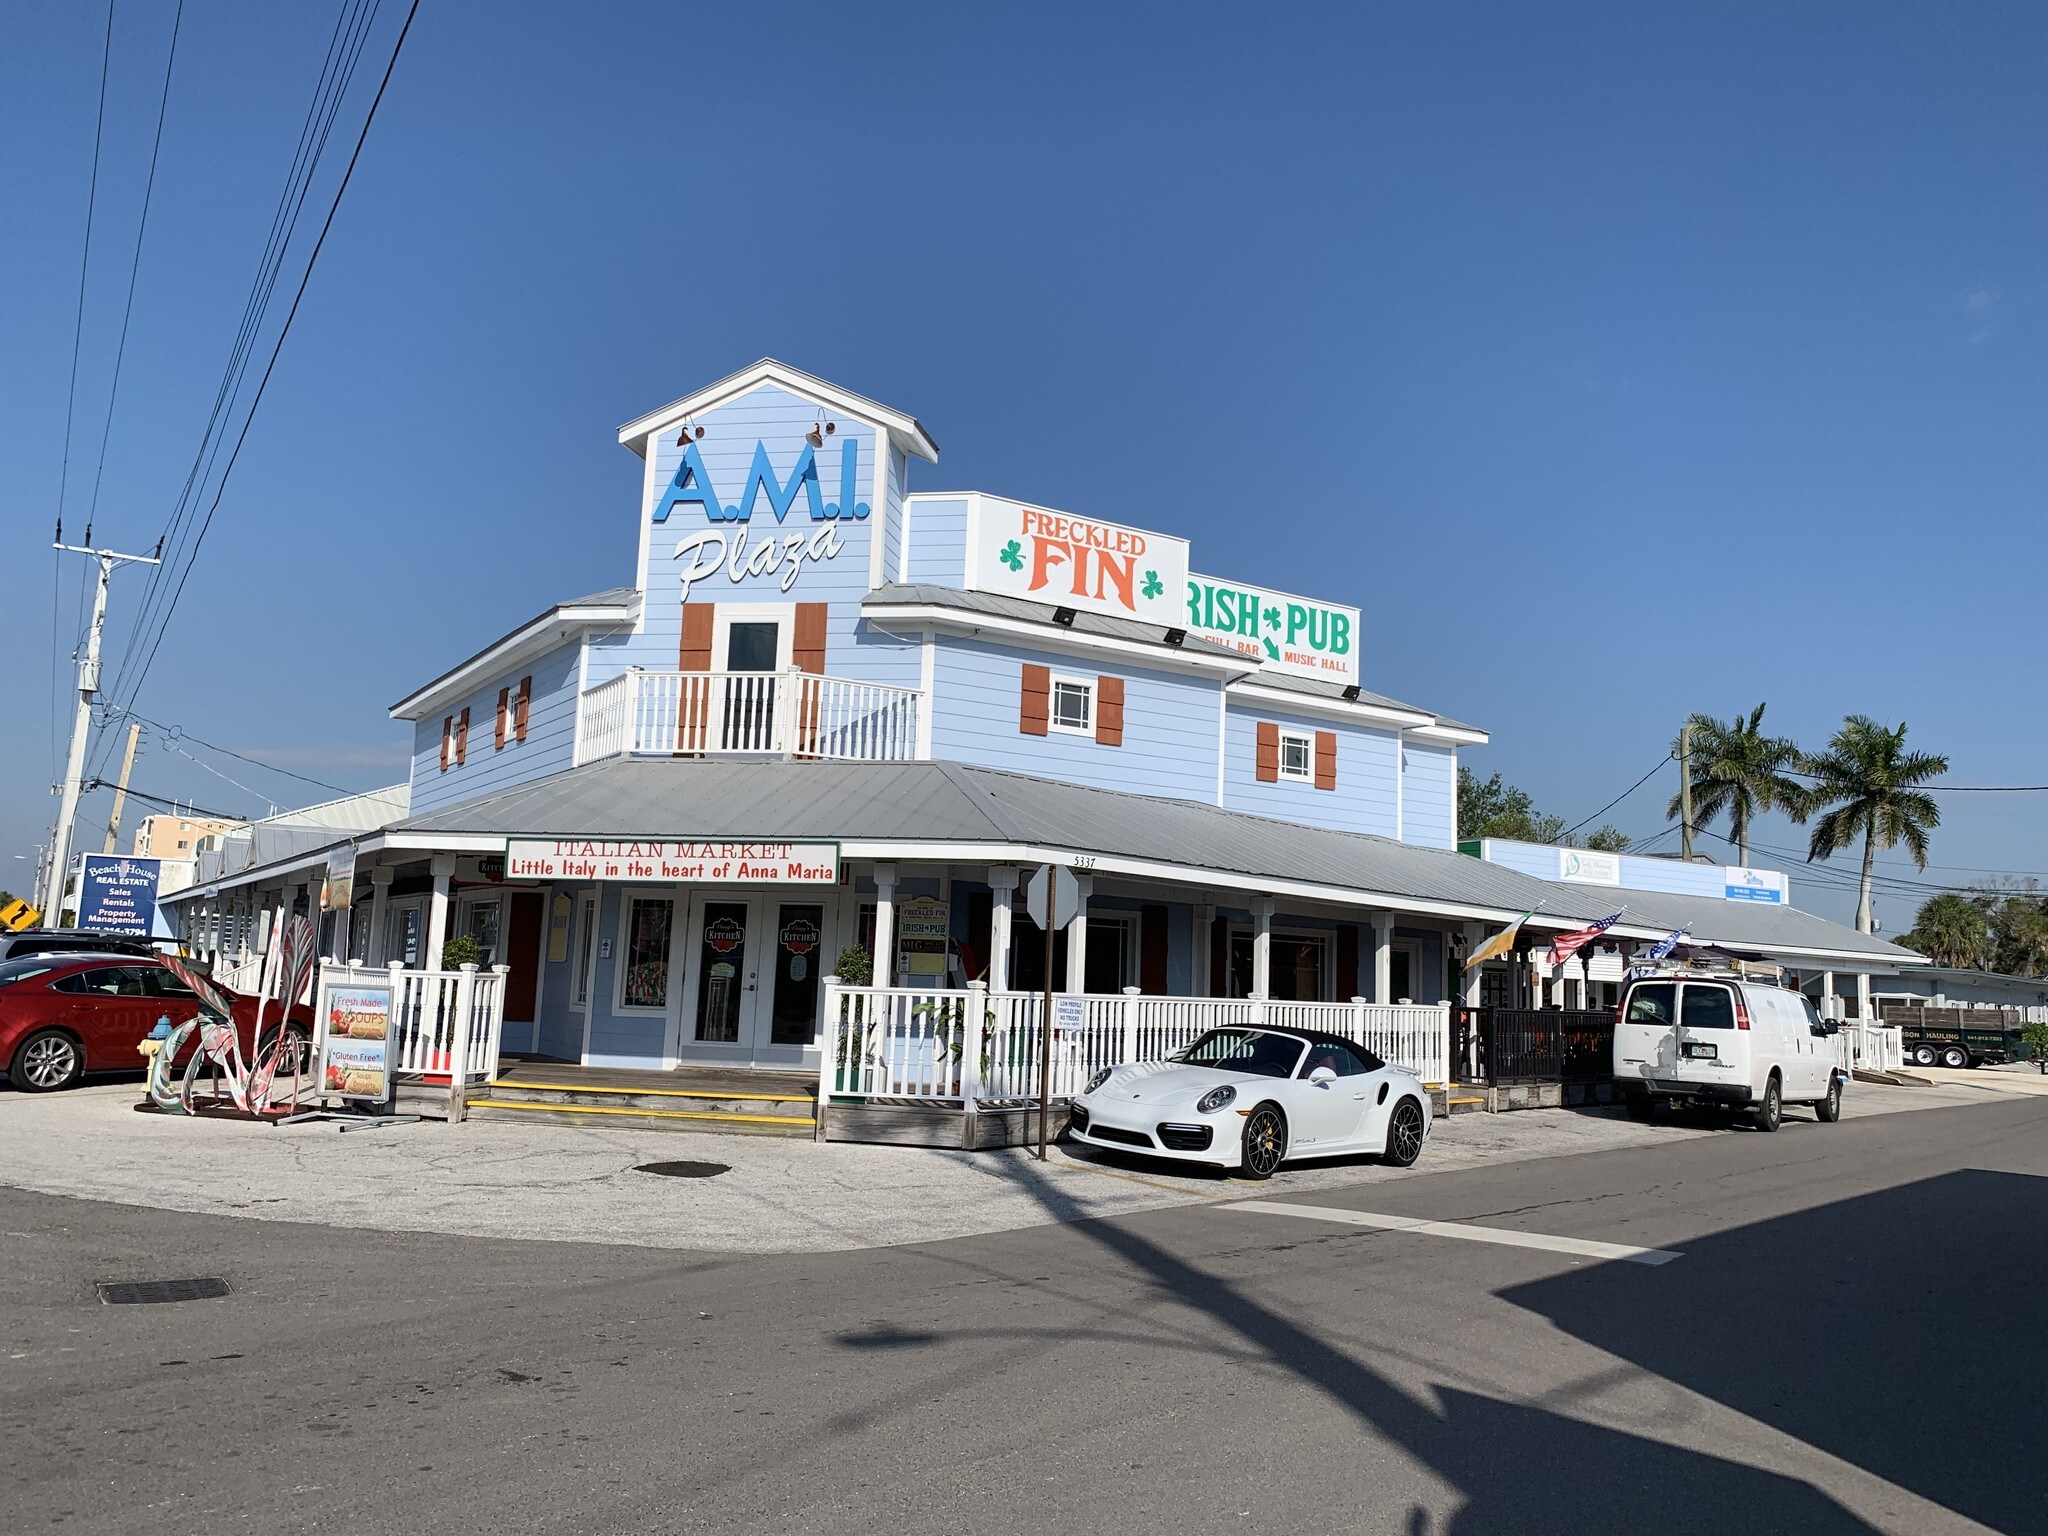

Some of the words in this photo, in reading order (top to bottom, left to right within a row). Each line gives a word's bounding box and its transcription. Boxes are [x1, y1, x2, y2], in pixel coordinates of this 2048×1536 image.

[651, 439, 870, 524] A.M.I.
[1021, 509, 1147, 557] FRECKLED
[673, 521, 847, 603] Plaza
[1027, 534, 1139, 613] FIN
[1187, 581, 1261, 639] RISH
[1285, 602, 1350, 656] PUB
[1238, 641, 1260, 656] BAR
[1284, 651, 1317, 667] MUSIC
[1321, 658, 1349, 673] HALL
[553, 840, 664, 858] ITALIAN
[674, 842, 793, 860] MARKET
[1074, 856, 1096, 868] 5337
[88, 863, 121, 878] Beach
[126, 864, 157, 881] House
[511, 859, 553, 875] Little
[562, 860, 597, 879] Italy
[605, 861, 619, 877] in
[627, 861, 653, 877] the
[662, 860, 704, 878] heart
[713, 862, 730, 879] of
[737, 862, 778, 879] Anna
[788, 863, 833, 880] Maria
[96, 877, 117, 885] REAL
[119, 877, 149, 887] ESTATE
[109, 888, 131, 896] Sales
[103, 898, 135, 907] Rentals
[88, 915, 145, 925] Management
[98, 909, 137, 919] Property
[902, 923, 924, 932] IRISH
[929, 924, 946, 933] PUB
[708, 930, 741, 940] KITCHEN
[784, 932, 817, 942] KITCHEN
[337, 996, 359, 1007] Fresh
[360, 998, 382, 1008] Made
[350, 1011, 384, 1024] SOUPS
[1926, 1032, 1960, 1040] HAULING
[356, 1072, 372, 1081] Soups
[353, 1080, 376, 1089] Desserts
